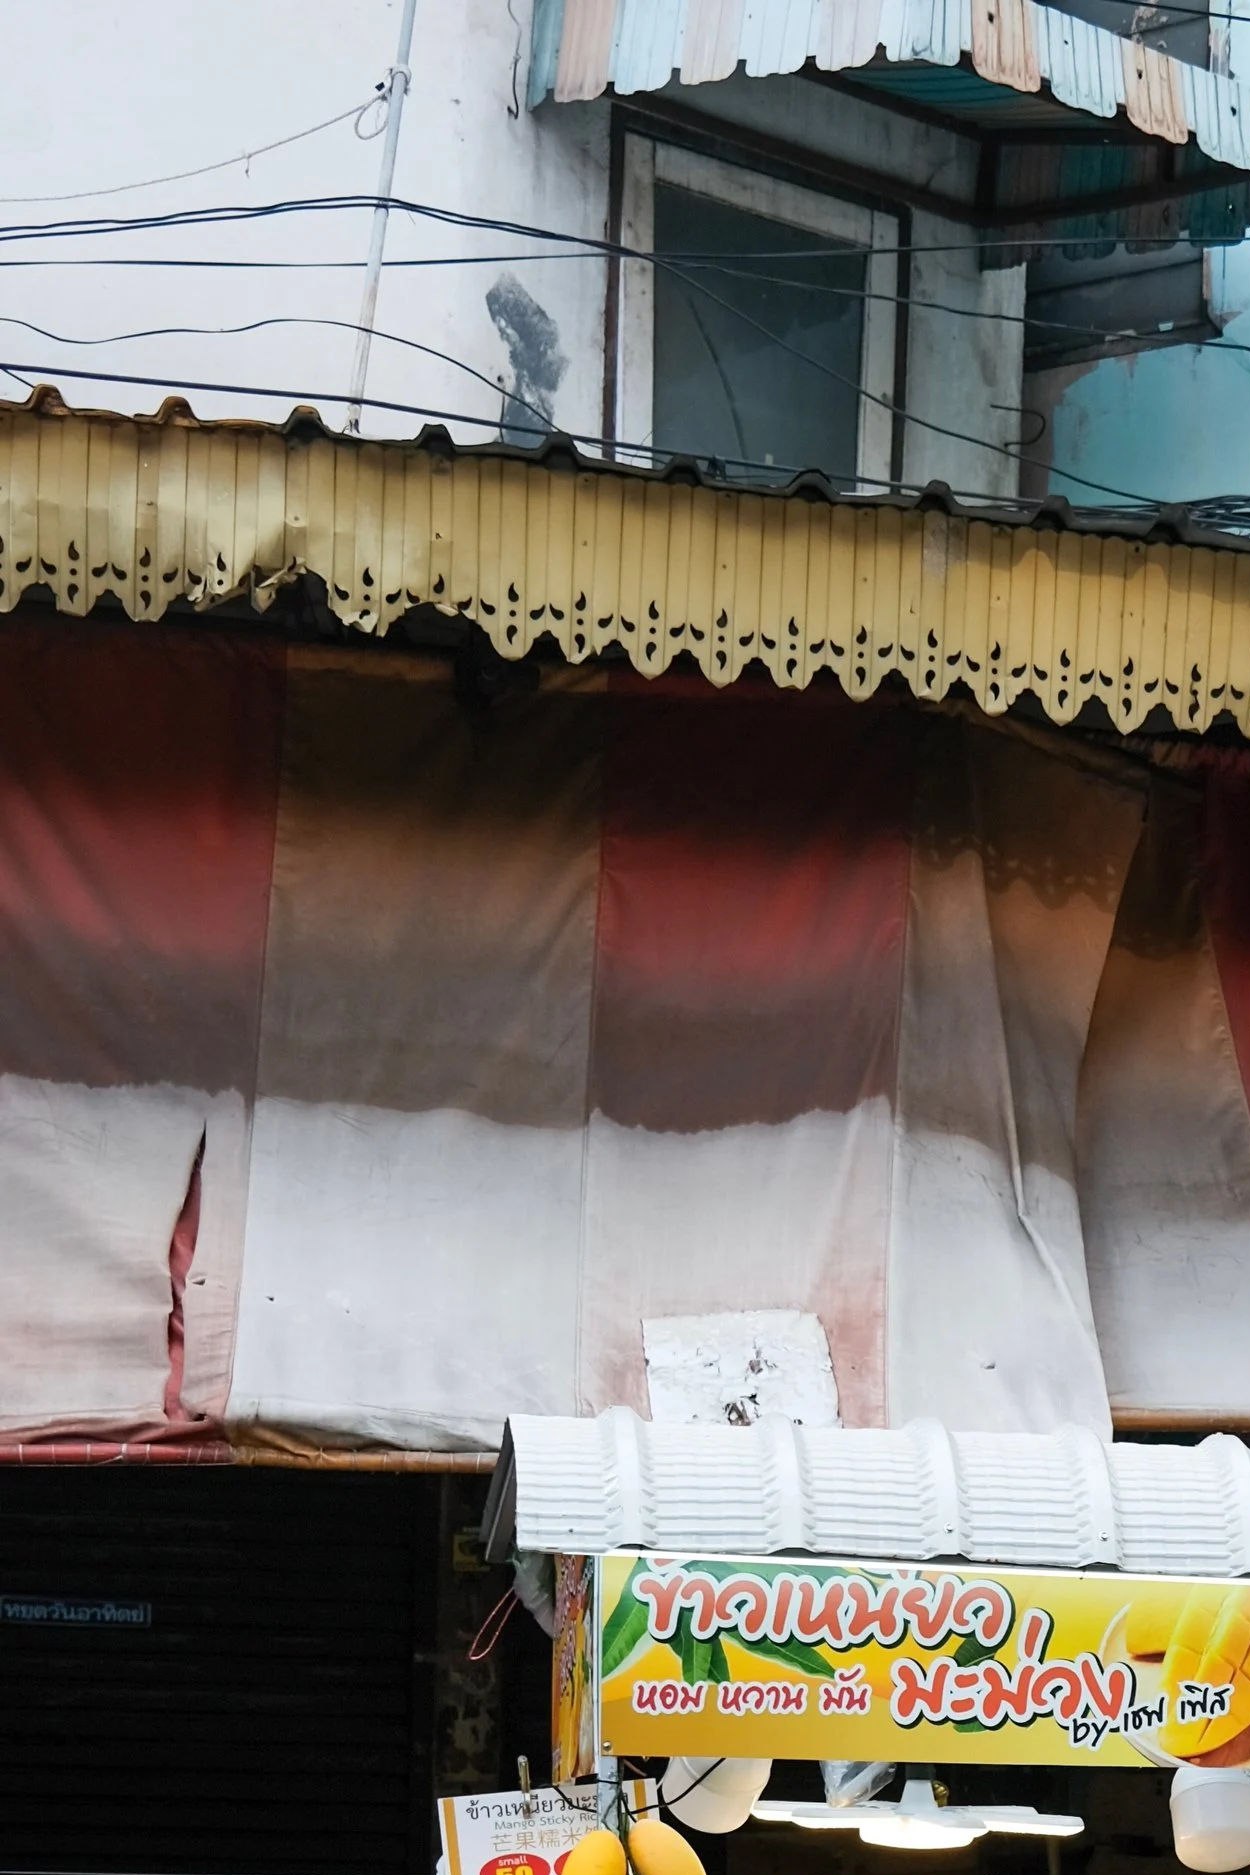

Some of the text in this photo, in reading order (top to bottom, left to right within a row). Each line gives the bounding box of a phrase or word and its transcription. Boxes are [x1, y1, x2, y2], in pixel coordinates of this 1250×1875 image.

[633, 1558, 1012, 1650] ขาวเหนยว
[891, 1608, 1132, 1725] มะม่วง
[634, 1665, 871, 1714] หอม หวาน มัน
[1071, 1717, 1109, 1748] by
[494, 1812, 597, 1831] Mango Sticky Ric
[490, 1826, 598, 1852] 芒果糯米
[498, 1855, 529, 1867] small
